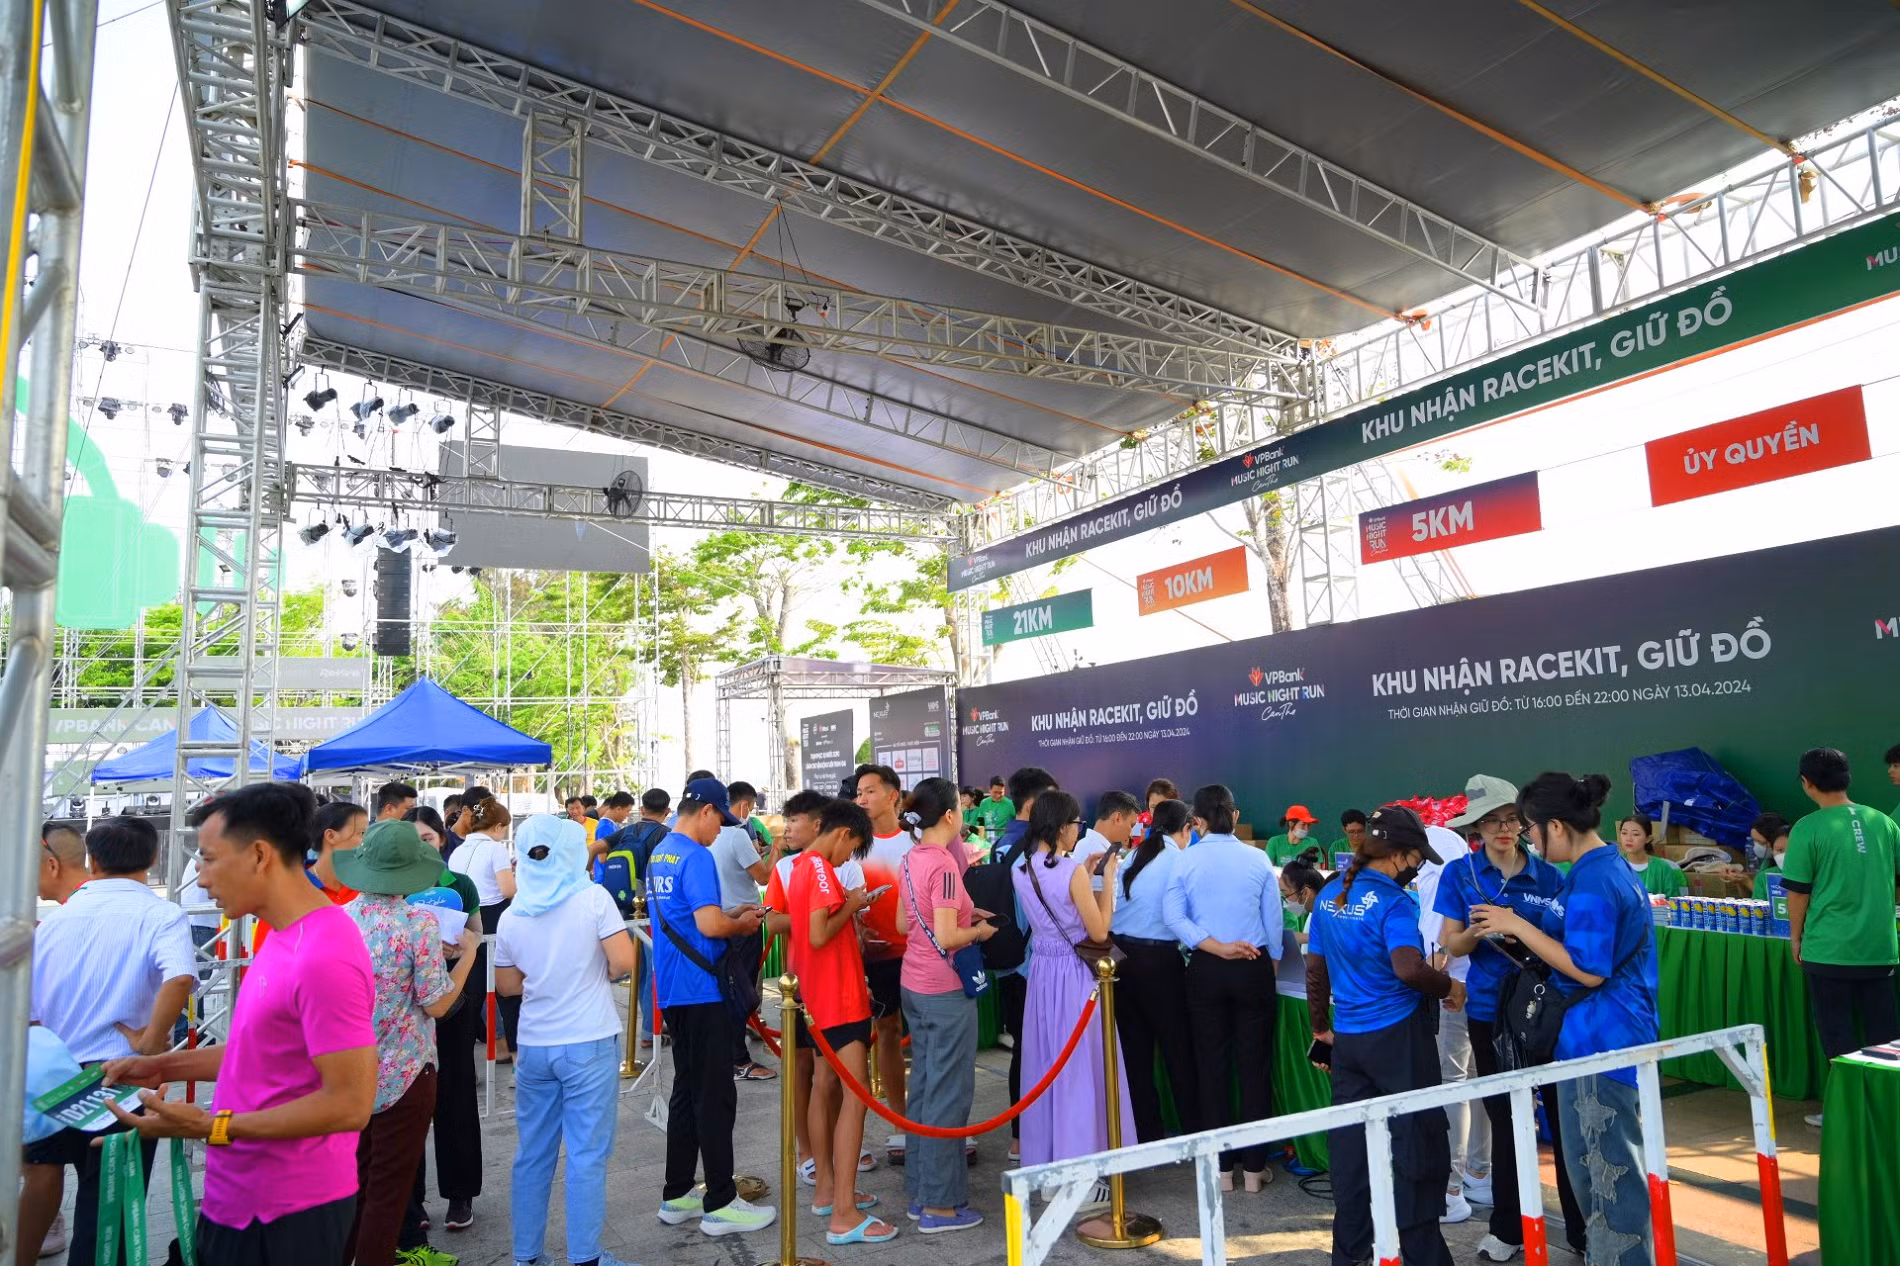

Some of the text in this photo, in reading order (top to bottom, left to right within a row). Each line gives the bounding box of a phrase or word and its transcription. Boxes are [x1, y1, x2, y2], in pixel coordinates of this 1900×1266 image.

[1866, 246, 1900, 270] MU
[1362, 286, 1733, 444] KHU NHẬN RACEKIT, GIỮ ĐỒ
[1255, 447, 1284, 465] VPBank
[1683, 420, 1820, 474] ỦY QUYỀN
[1231, 455, 1299, 487] MUSIC NIGHT RUN
[1025, 483, 1183, 558] KHU NHẬN RACEKIT, GIỮ ĐỒ
[1412, 500, 1474, 542] 5KM
[1164, 566, 1214, 600] 10KM
[1013, 605, 1053, 635] 21KM
[1875, 617, 1900, 639] M
[1372, 616, 1772, 697] KHU NHẬN RACEKIT, GIỮ ĐỒ
[1265, 667, 1304, 685] VPBank
[1031, 689, 1198, 732] KHU NHẬN RACEKIT, GIỮ ĐỒ
[1234, 684, 1325, 707] MUSIC NIGHT RUN
[1388, 705, 1411, 719] THỜI
[1412, 706, 1437, 718] GIAN
[1439, 702, 1468, 717] NHẬN
[1470, 699, 1489, 714] GIỮ
[1515, 695, 1530, 710] TỪ
[1532, 695, 1562, 709] 16:00
[1565, 688, 1591, 706] ĐẾN
[1594, 689, 1629, 704] 22:00
[1633, 684, 1670, 701] NGÀY
[1674, 679, 1751, 698] 13.04.2024
[963, 725, 980, 736] MUSIC
[1852, 820, 1867, 854] CREW
[1320, 899, 1365, 917] NEXUS
